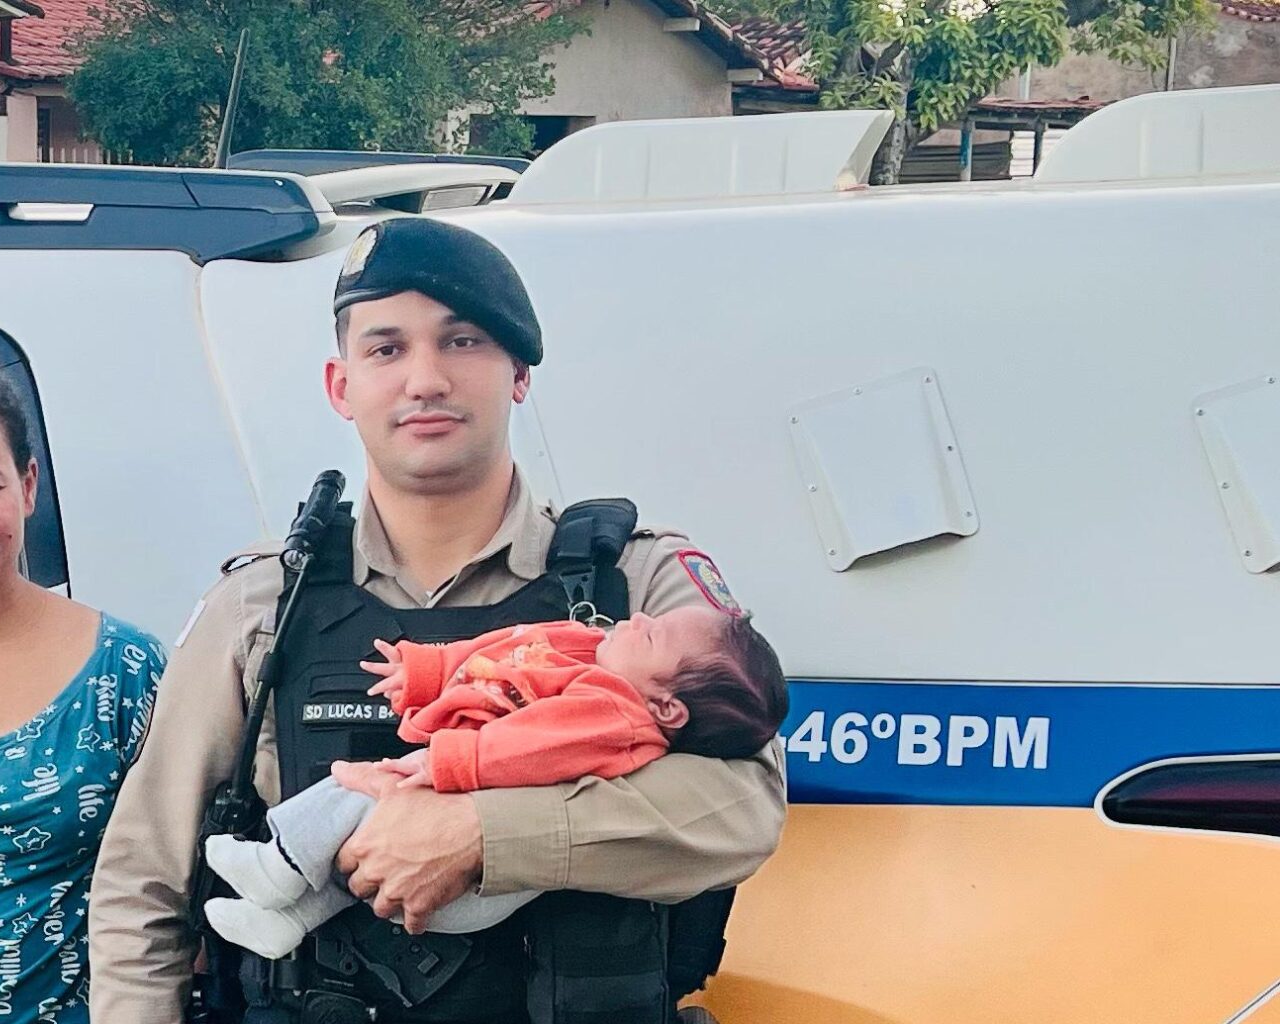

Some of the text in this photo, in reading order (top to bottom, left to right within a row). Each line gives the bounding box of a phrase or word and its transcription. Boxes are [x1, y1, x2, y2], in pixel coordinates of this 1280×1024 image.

[306, 705, 323, 719] SD
[328, 704, 373, 719] LUCAS
[785, 710, 1051, 770] 46ºBPM
